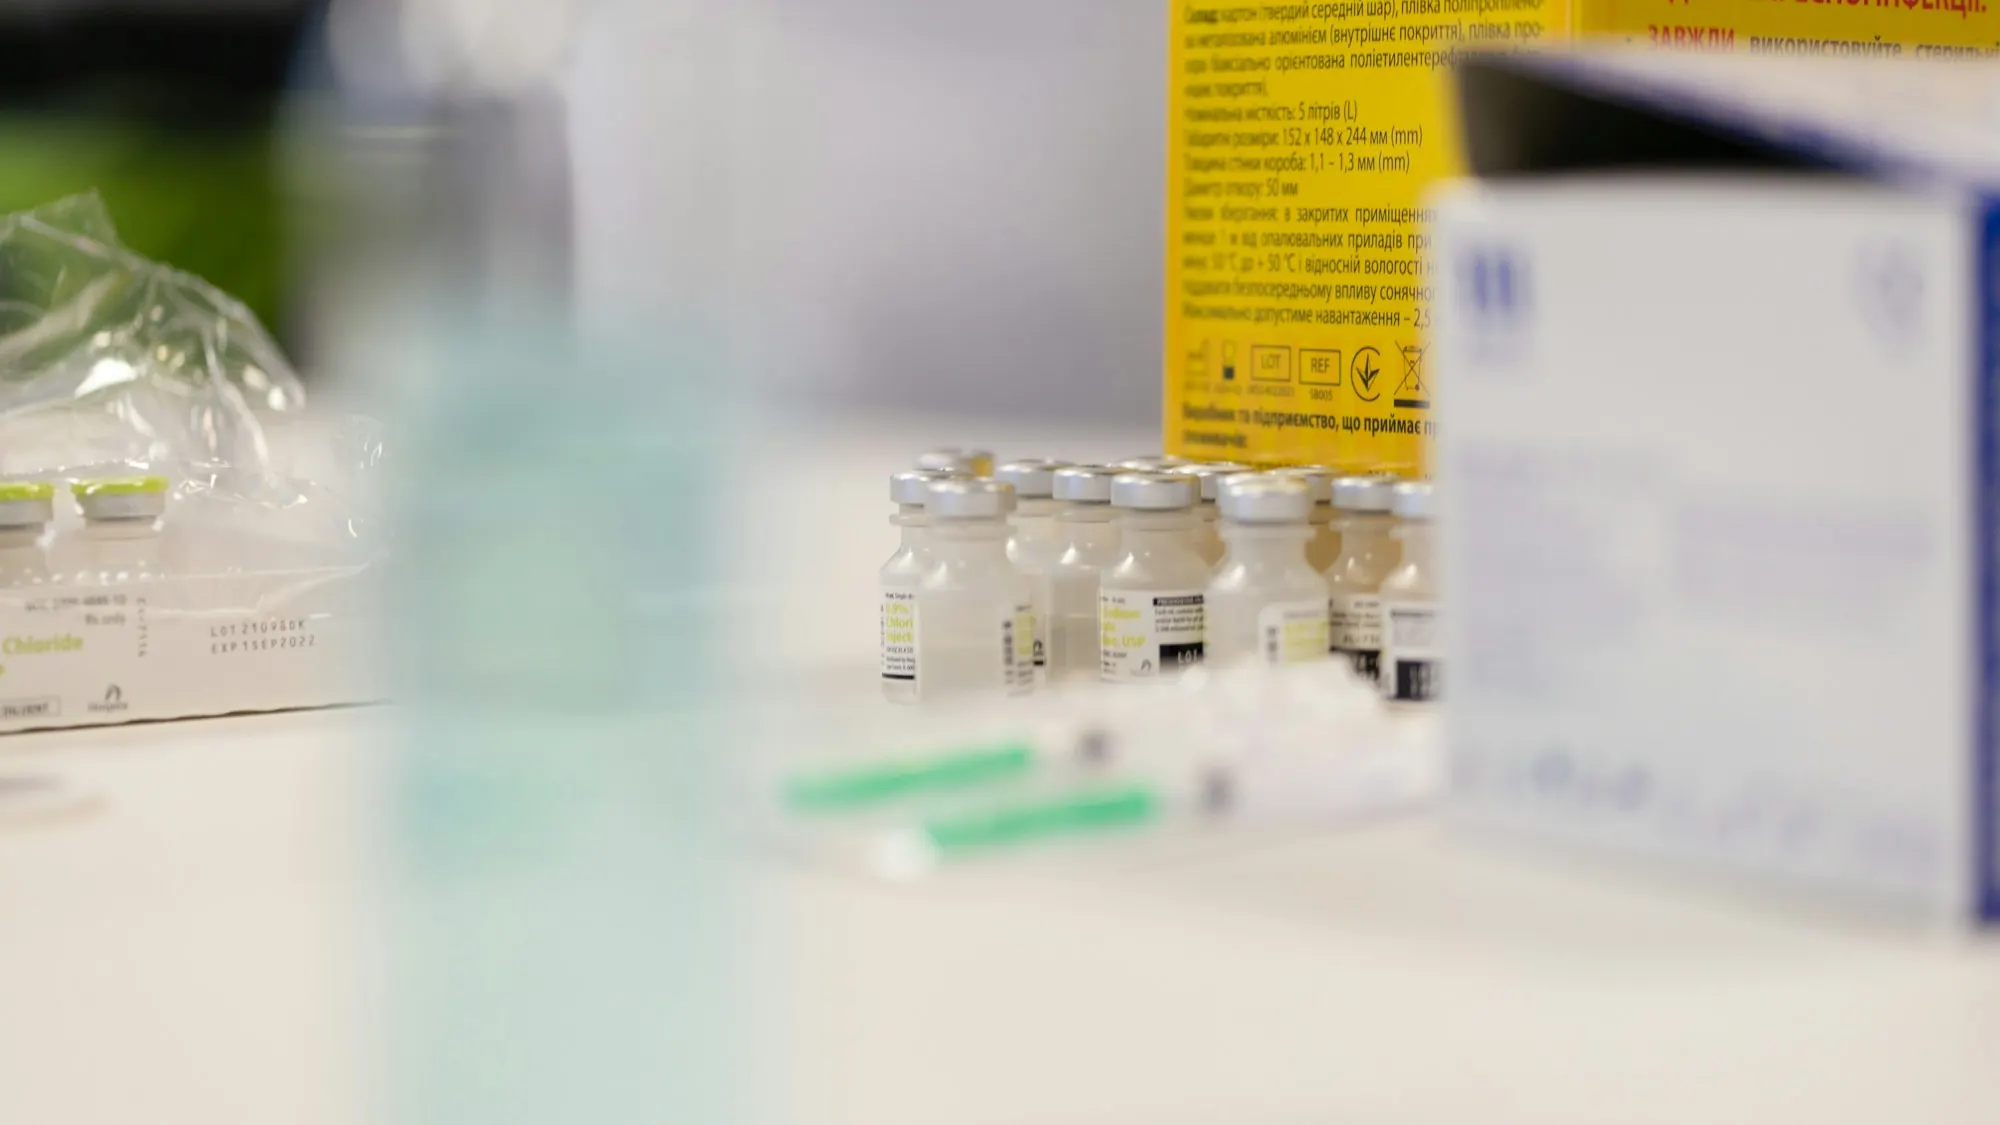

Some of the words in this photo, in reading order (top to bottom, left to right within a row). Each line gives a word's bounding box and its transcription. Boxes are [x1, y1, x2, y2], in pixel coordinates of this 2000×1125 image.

[1311, 0, 1364, 22] середній
[1367, 0, 1398, 19] шар),
[1401, 0, 1441, 14] плівка
[1269, 26, 1326, 45] алюмінієм
[1330, 23, 1395, 48] (внутрішнє
[1399, 19, 1465, 44] покриття),
[1469, 19, 1511, 40] плівка
[1648, 25, 1735, 52] ЗАВЖДИ
[1275, 51, 1344, 76] орієнтована
[1298, 102, 1306, 120] 5
[1307, 103, 1341, 123] літрів
[1343, 100, 1358, 122] (L)
[1283, 127, 1301, 145] 152
[1314, 127, 1333, 145] 148
[1346, 127, 1366, 145] 244
[1369, 131, 1388, 145] мм
[1391, 125, 1423, 148] (mm)
[1310, 153, 1325, 173] 1,1
[1339, 153, 1354, 173] 1,3
[1357, 157, 1375, 171] мм
[1378, 152, 1410, 174] (mm)
[1266, 178, 1279, 197] 50
[1281, 182, 1298, 196] мм
[1296, 206, 1348, 226] закритих
[1261, 231, 1343, 248] опалювальних
[1348, 230, 1403, 253] приладів
[1408, 233, 1431, 254] при
[1305, 254, 1360, 277] відносній
[1364, 256, 1423, 276] вологості
[1335, 283, 1376, 304] впливу
[1316, 310, 1400, 327] навантаження
[1261, 354, 1281, 370] LOT
[1311, 357, 1330, 374] REF
[1253, 405, 1339, 431] підприємство,
[1342, 415, 1361, 434] що
[1364, 413, 1421, 437] приймає
[210, 624, 236, 637] LOT
[886, 616, 914, 629] Chlori
[2, 632, 85, 656] Chloride
[210, 641, 237, 655] EXP
[886, 632, 913, 644] Inject
